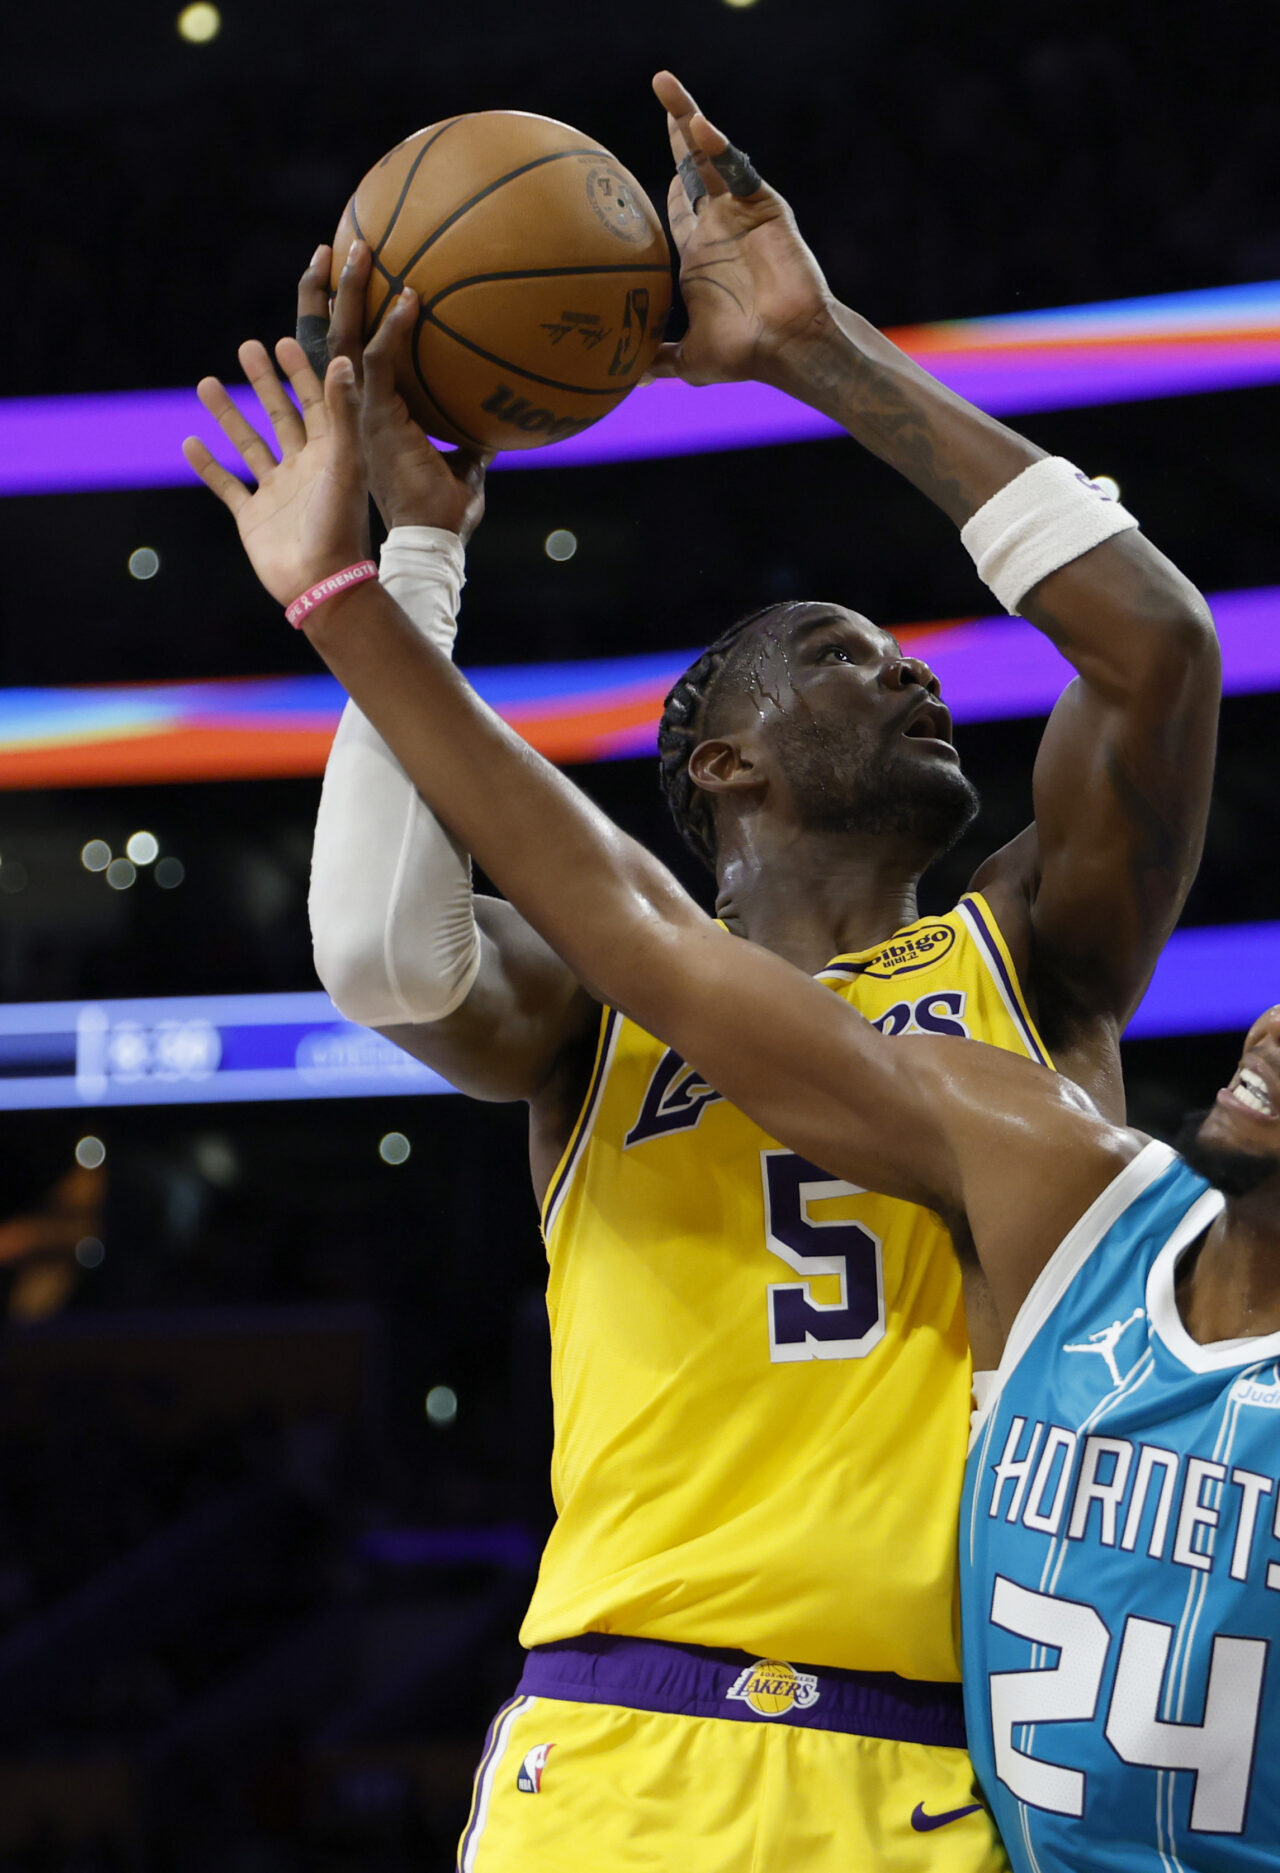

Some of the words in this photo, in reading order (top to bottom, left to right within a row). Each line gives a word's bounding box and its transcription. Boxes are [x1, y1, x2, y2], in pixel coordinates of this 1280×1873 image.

[760, 1149, 886, 1364] 5
[734, 1671, 813, 1705] LAKERS
[988, 1573, 1271, 1836] 24
